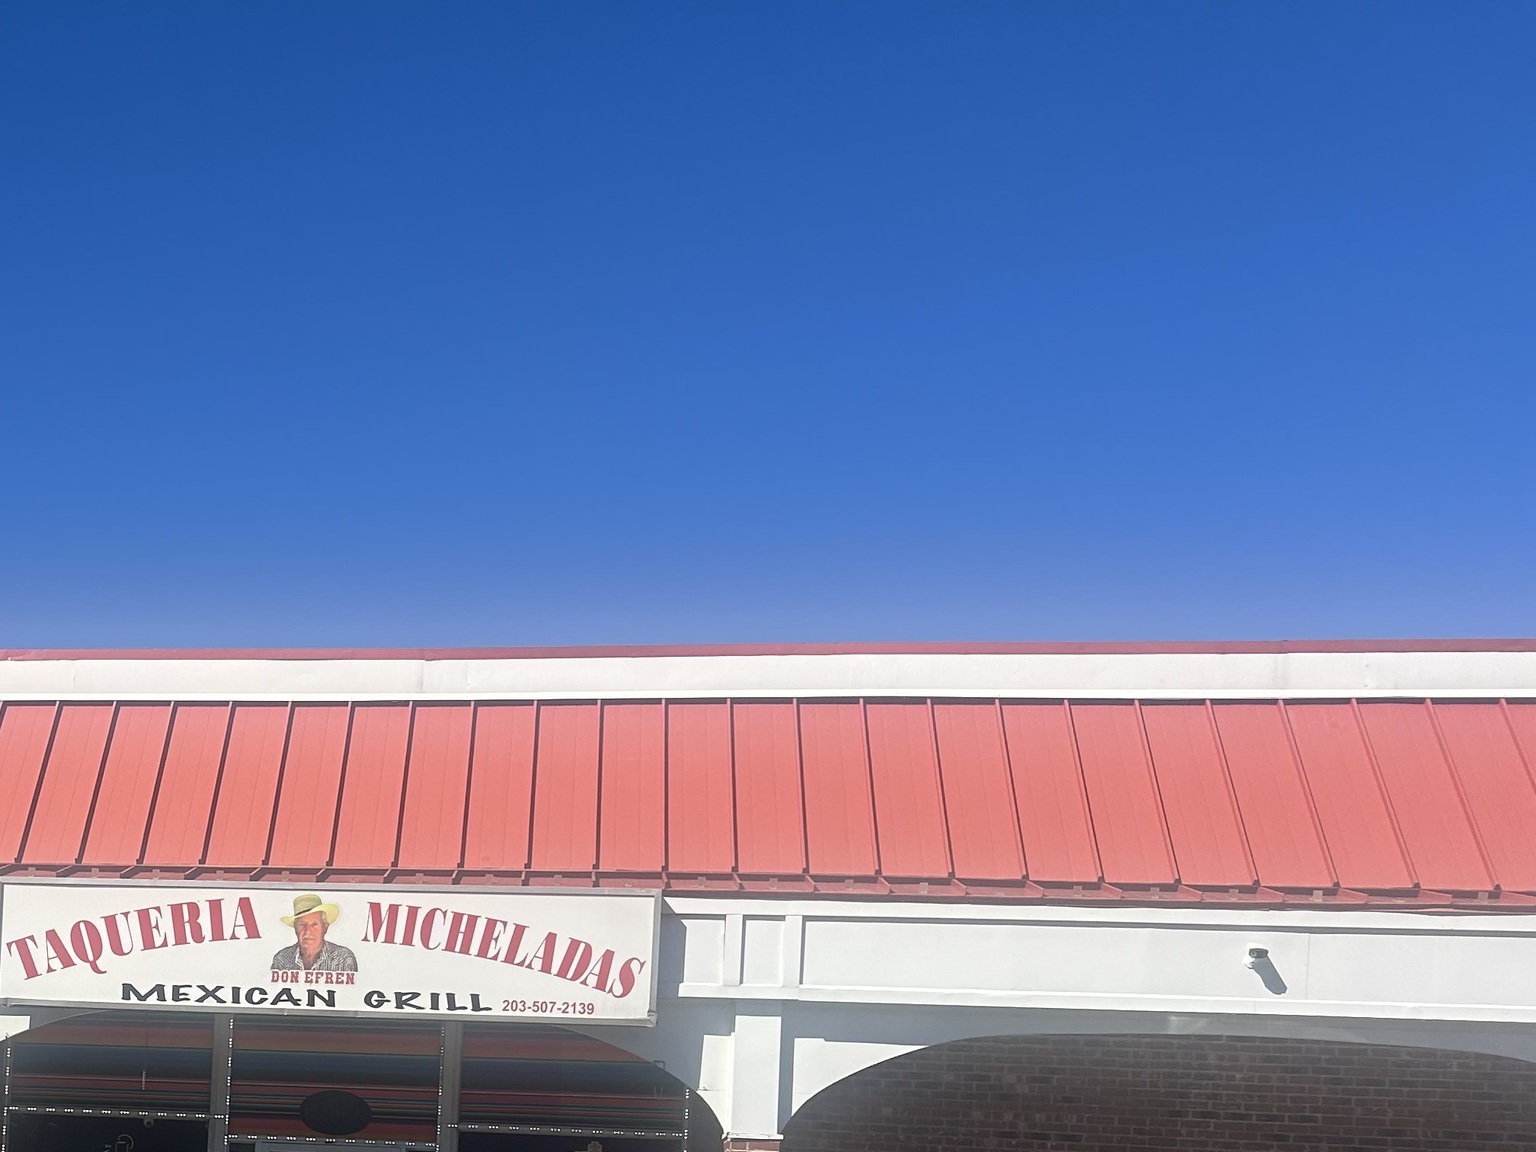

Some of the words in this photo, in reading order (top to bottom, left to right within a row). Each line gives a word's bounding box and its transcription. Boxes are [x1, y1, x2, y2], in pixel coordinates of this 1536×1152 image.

[6, 897, 262, 981] TAQUERIA
[361, 901, 647, 999] MICHELADAS
[271, 971, 300, 984] DON
[304, 971, 356, 985] EFREN
[121, 983, 337, 1008] MEXICAN
[363, 990, 493, 1013] GRILL
[502, 1000, 595, 1016] 203-507-2139
